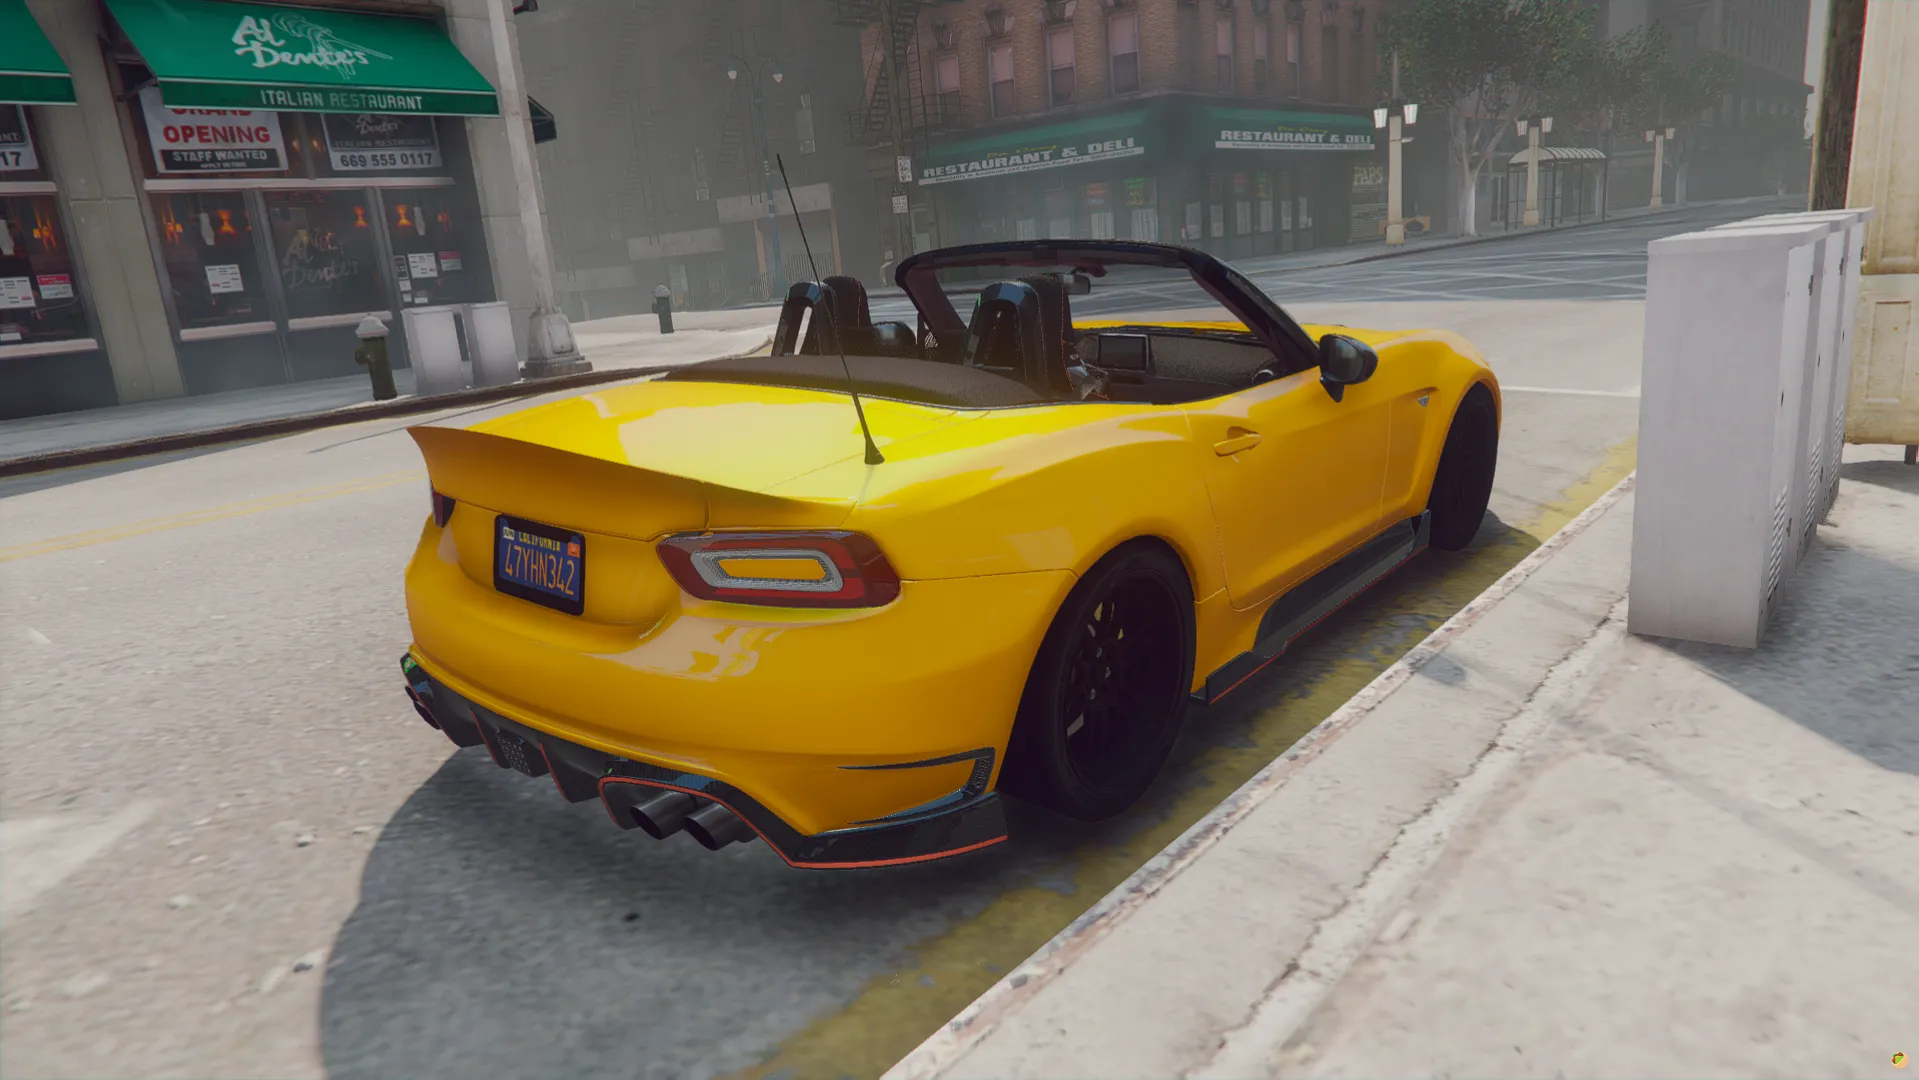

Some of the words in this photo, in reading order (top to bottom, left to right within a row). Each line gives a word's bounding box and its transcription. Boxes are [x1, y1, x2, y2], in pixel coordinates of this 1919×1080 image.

[232, 15, 286, 46] Al
[235, 41, 369, 69] Dente's
[260, 90, 324, 108] ITALIAN
[330, 93, 423, 111] RESTAURANT
[163, 125, 270, 144] OPENING
[1220, 130, 1327, 143] RESTAURANT
[1329, 133, 1340, 143] &
[1345, 134, 1371, 144] DELI
[173, 151, 213, 162] STAFF
[215, 150, 267, 162] WANTED
[340, 154, 367, 167] 669
[371, 153, 397, 167] 555
[400, 152, 433, 166] 0117
[923, 150, 1053, 178] RESTAURANT
[1061, 147, 1078, 158] &
[1087, 136, 1135, 154] DELI
[505, 542, 575, 596] 47YHN342
